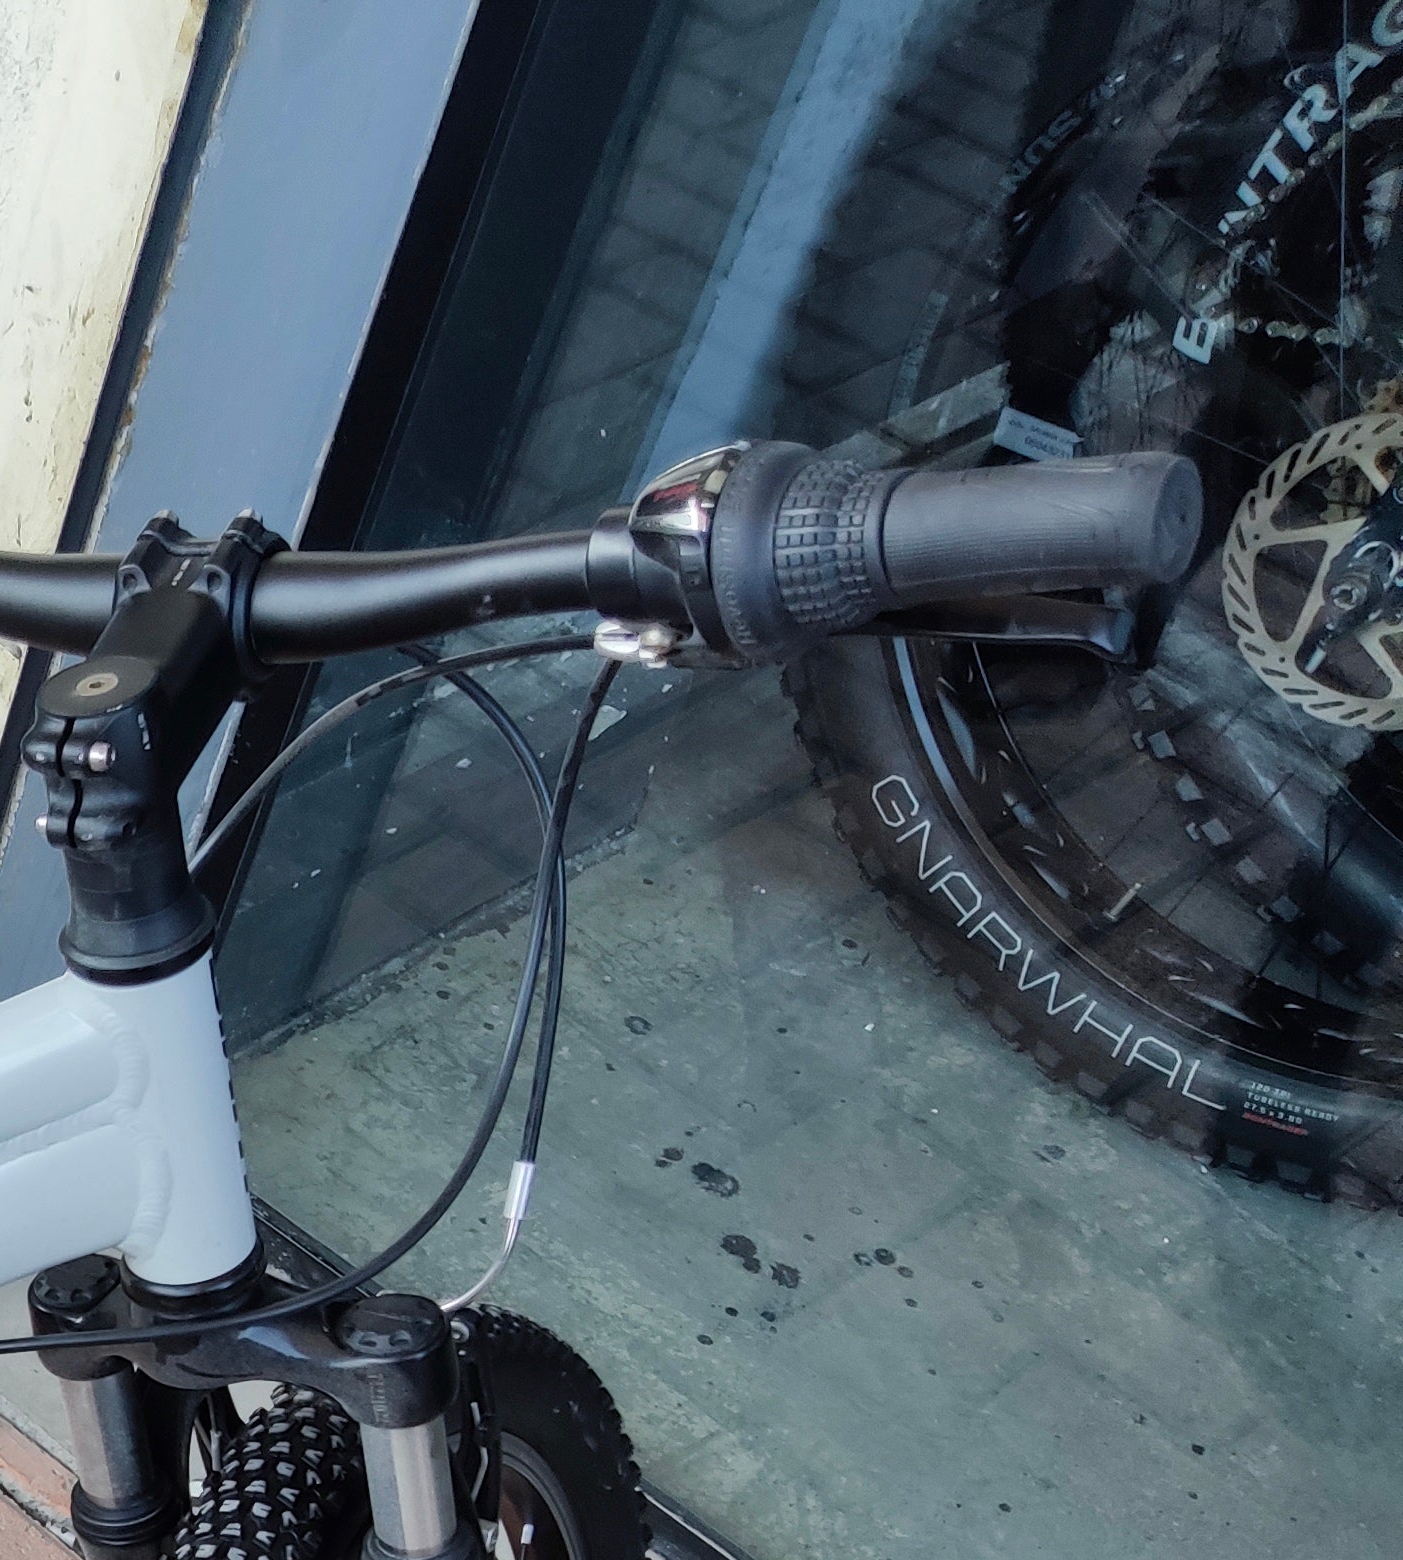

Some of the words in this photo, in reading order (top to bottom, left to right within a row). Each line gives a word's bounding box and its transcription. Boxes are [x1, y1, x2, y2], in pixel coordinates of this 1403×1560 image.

[871, 774, 1227, 1111] GNARWHAL
[1247, 1091, 1301, 1114] TUBELESS
[1304, 1108, 1340, 1123] READY
